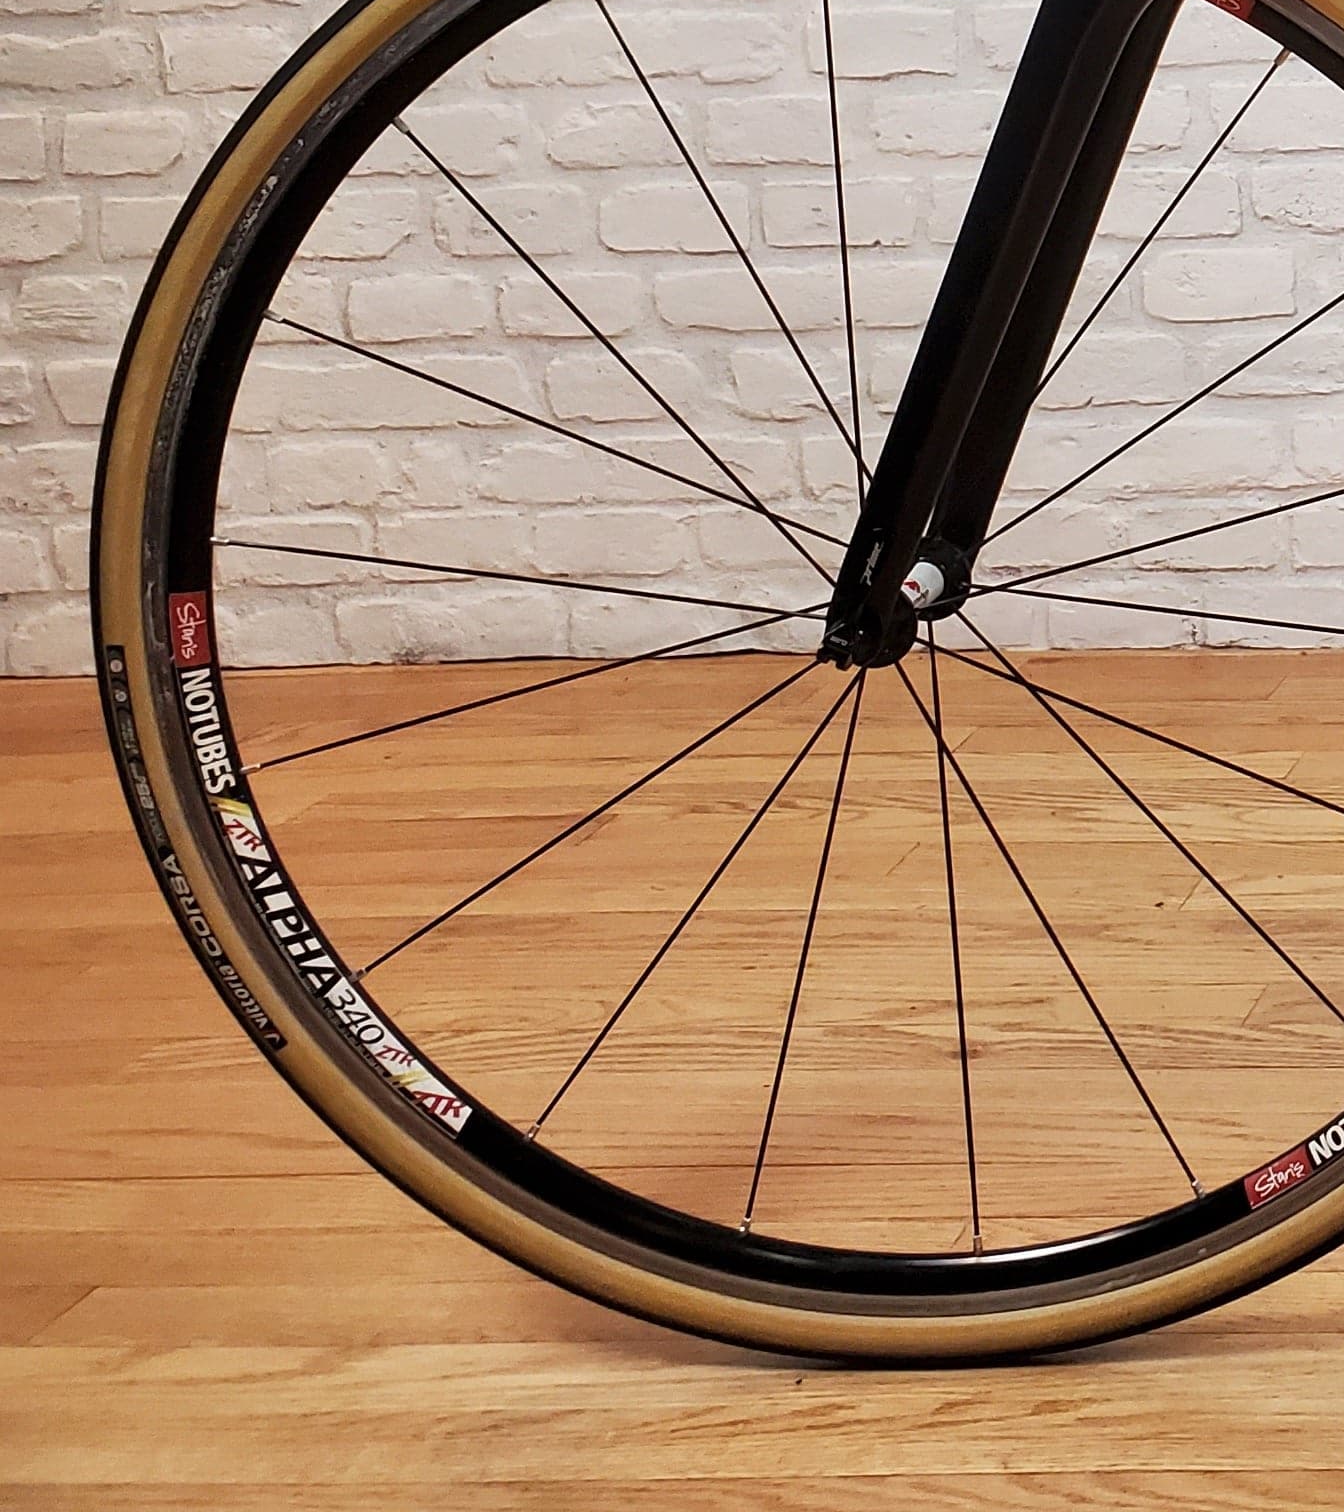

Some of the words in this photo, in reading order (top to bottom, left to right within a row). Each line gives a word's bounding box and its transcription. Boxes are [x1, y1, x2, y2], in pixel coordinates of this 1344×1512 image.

[176, 601, 206, 660] Stan's
[181, 667, 235, 795] NOTUBES
[224, 820, 262, 853] ZTR
[162, 855, 222, 958] CORSA
[237, 855, 344, 1000] ALPHA
[220, 963, 268, 1030] vittoria
[331, 986, 385, 1045] 340
[376, 1041, 417, 1069] ZTR
[1254, 1161, 1304, 1197] Stan's
